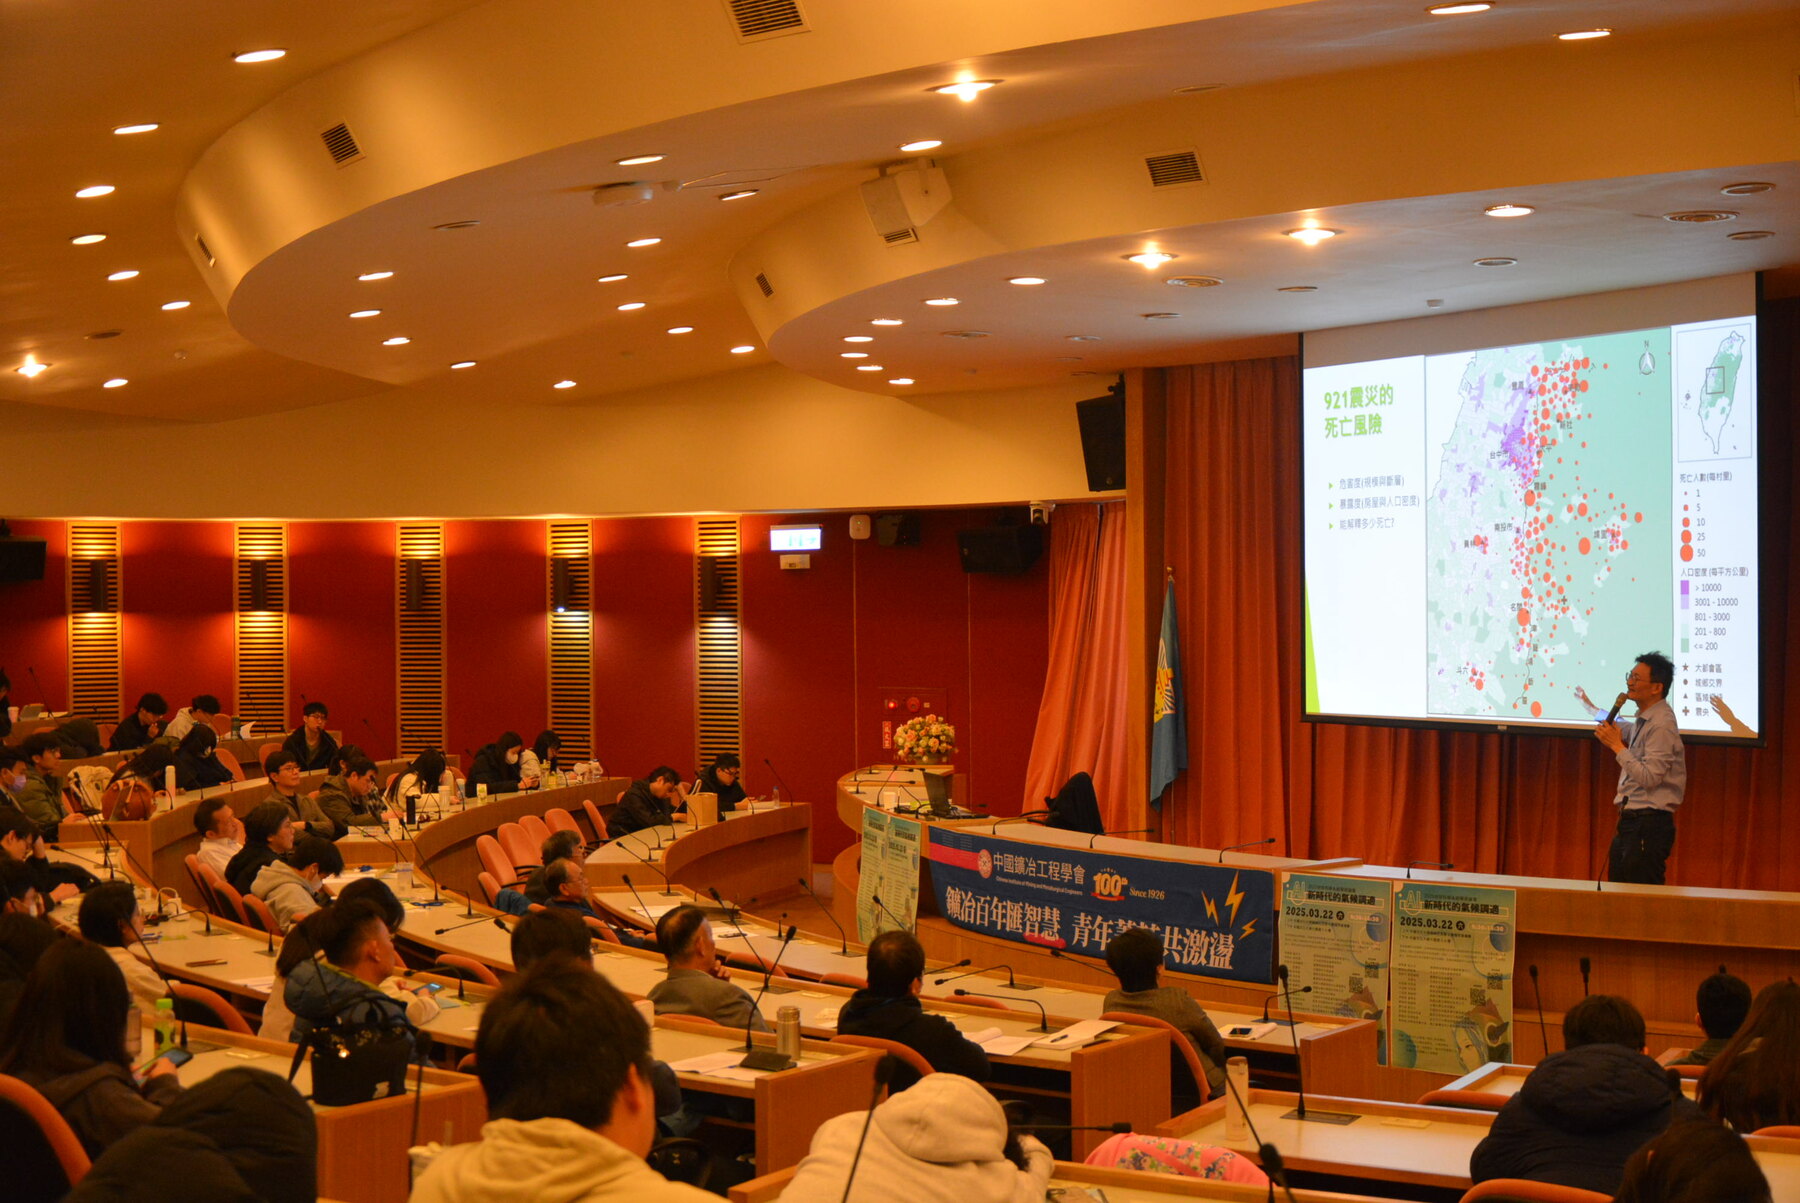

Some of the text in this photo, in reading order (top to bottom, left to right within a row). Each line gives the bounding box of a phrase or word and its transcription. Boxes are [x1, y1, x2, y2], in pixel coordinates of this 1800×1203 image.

[1324, 384, 1394, 410] 921震災的
[1324, 413, 1382, 438] 死亡風險
[1696, 503, 1701, 512] 5
[1696, 518, 1706, 526] 10
[1696, 532, 1706, 541] 25
[1697, 548, 1706, 557] 50
[1129, 888, 1165, 900] Since 1926
[1286, 906, 1334, 920] 2025.03.22
[1400, 916, 1453, 930] 2025.03.22
[1072, 912, 1234, 970] 青年共激盪
